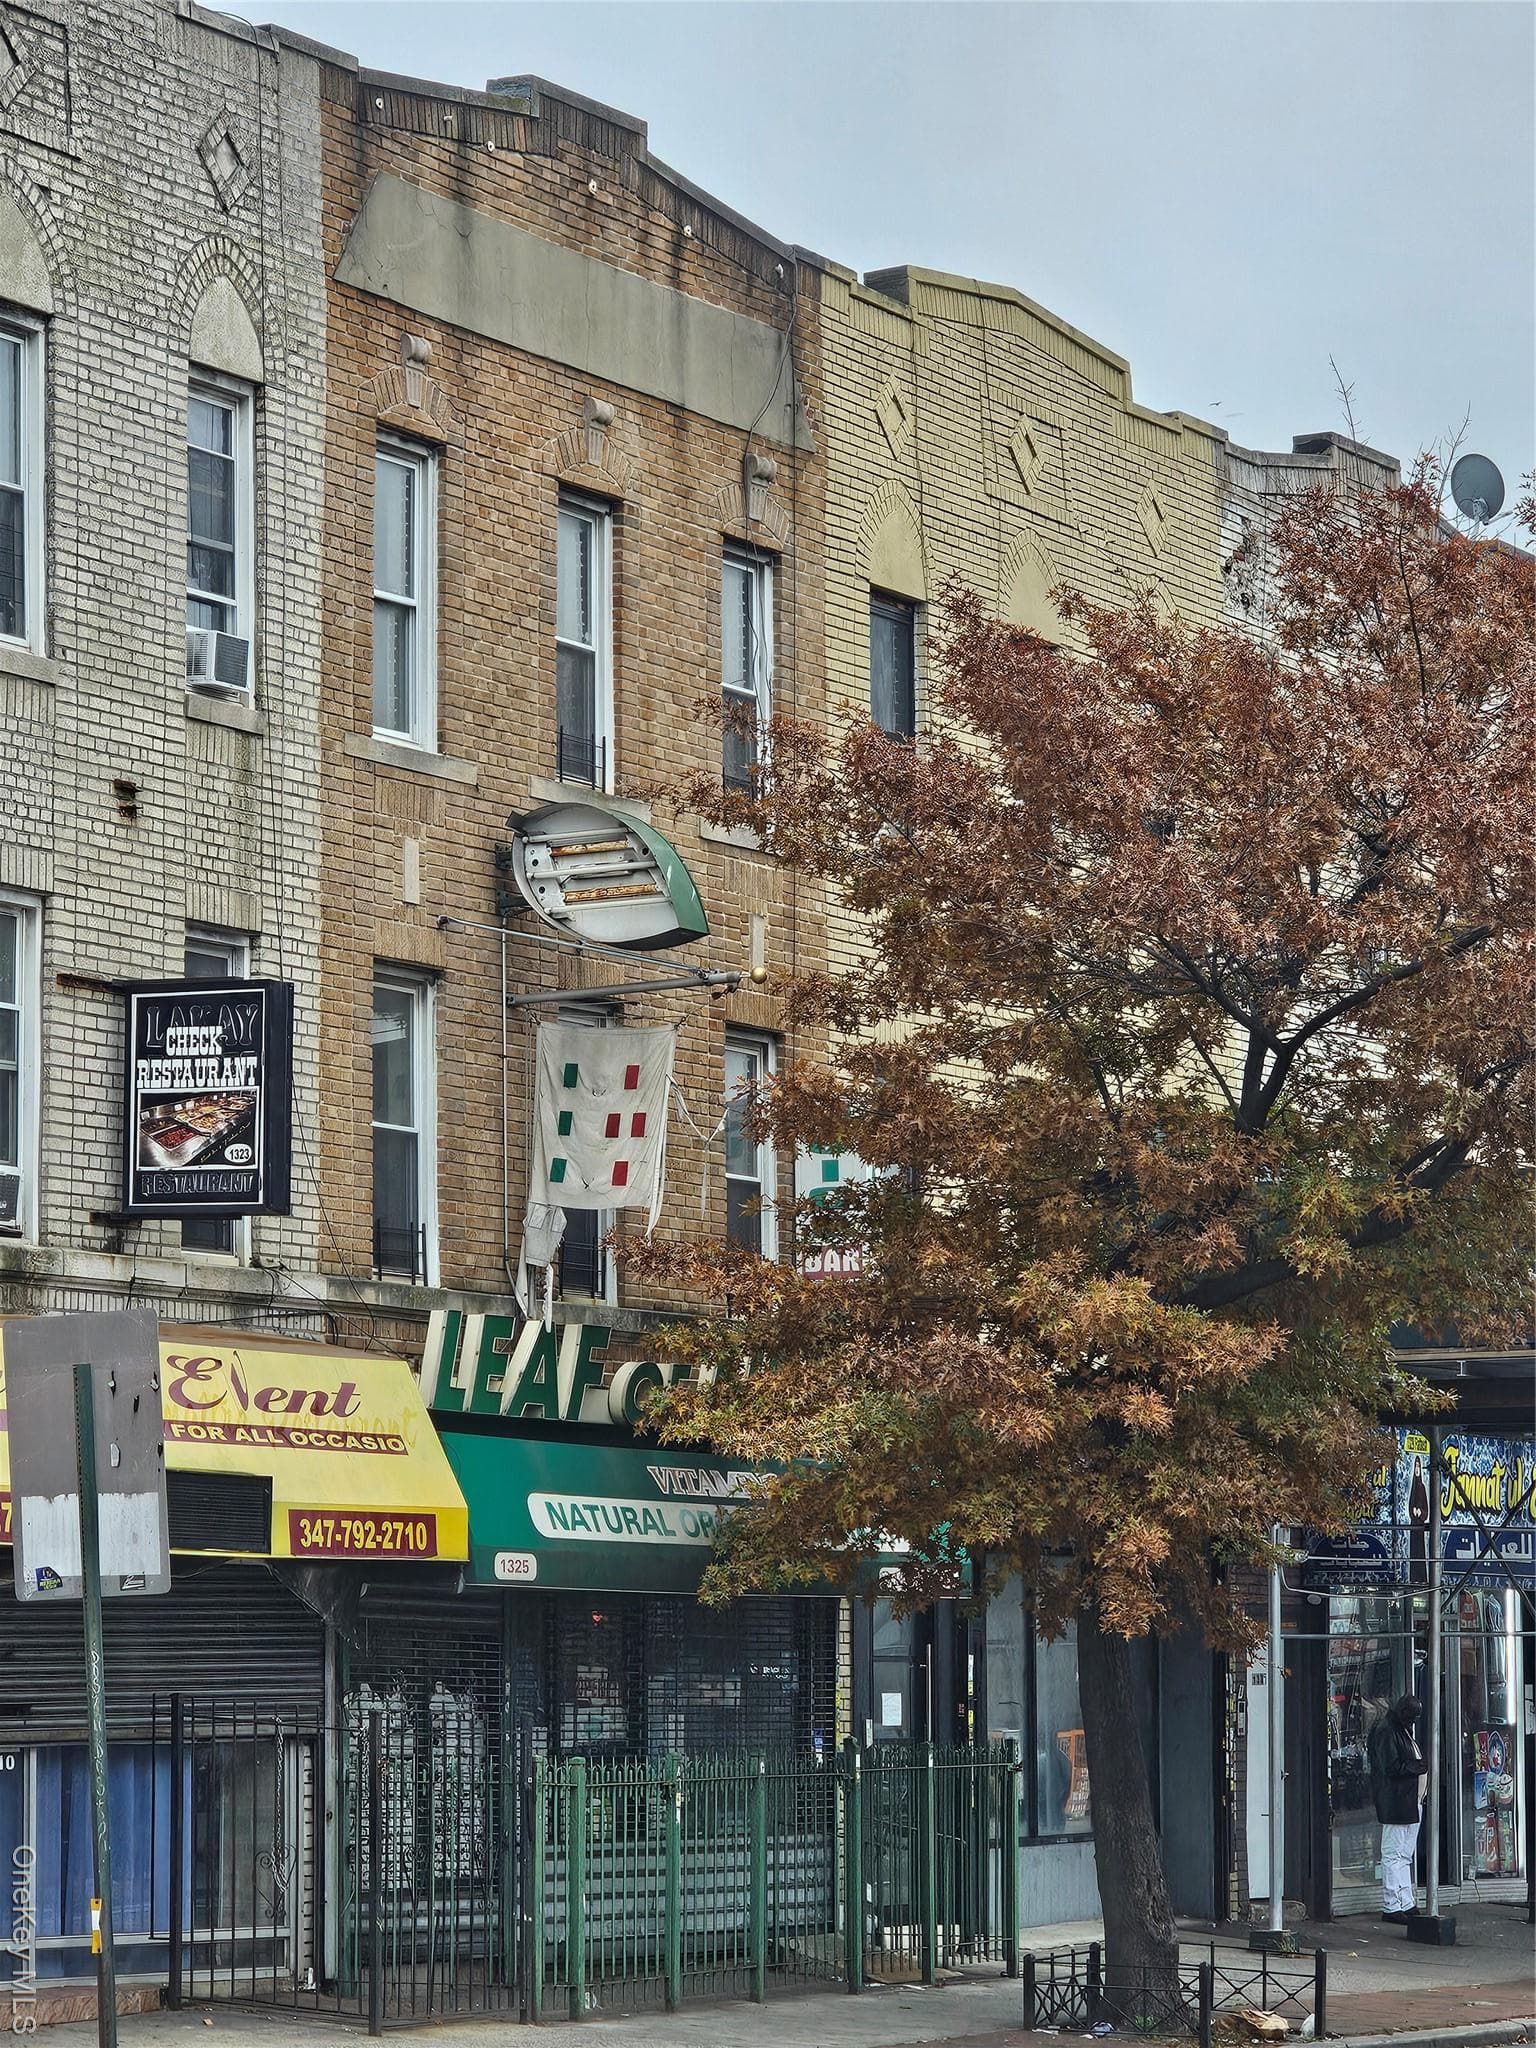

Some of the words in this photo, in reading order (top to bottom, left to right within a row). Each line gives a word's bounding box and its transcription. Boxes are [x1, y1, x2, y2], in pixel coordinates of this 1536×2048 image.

[166, 1026, 222, 1056] CHECK
[137, 1057, 257, 1088] RESTAURANT
[229, 1148, 250, 1160] 1323
[420, 1310, 612, 1421] LEAF
[171, 1424, 227, 1441] FOR
[235, 1428, 283, 1444] ALL
[544, 1500, 677, 1537] NATURAL
[300, 1518, 427, 1551] 347-792-2710
[500, 1557, 530, 1575] 1325
